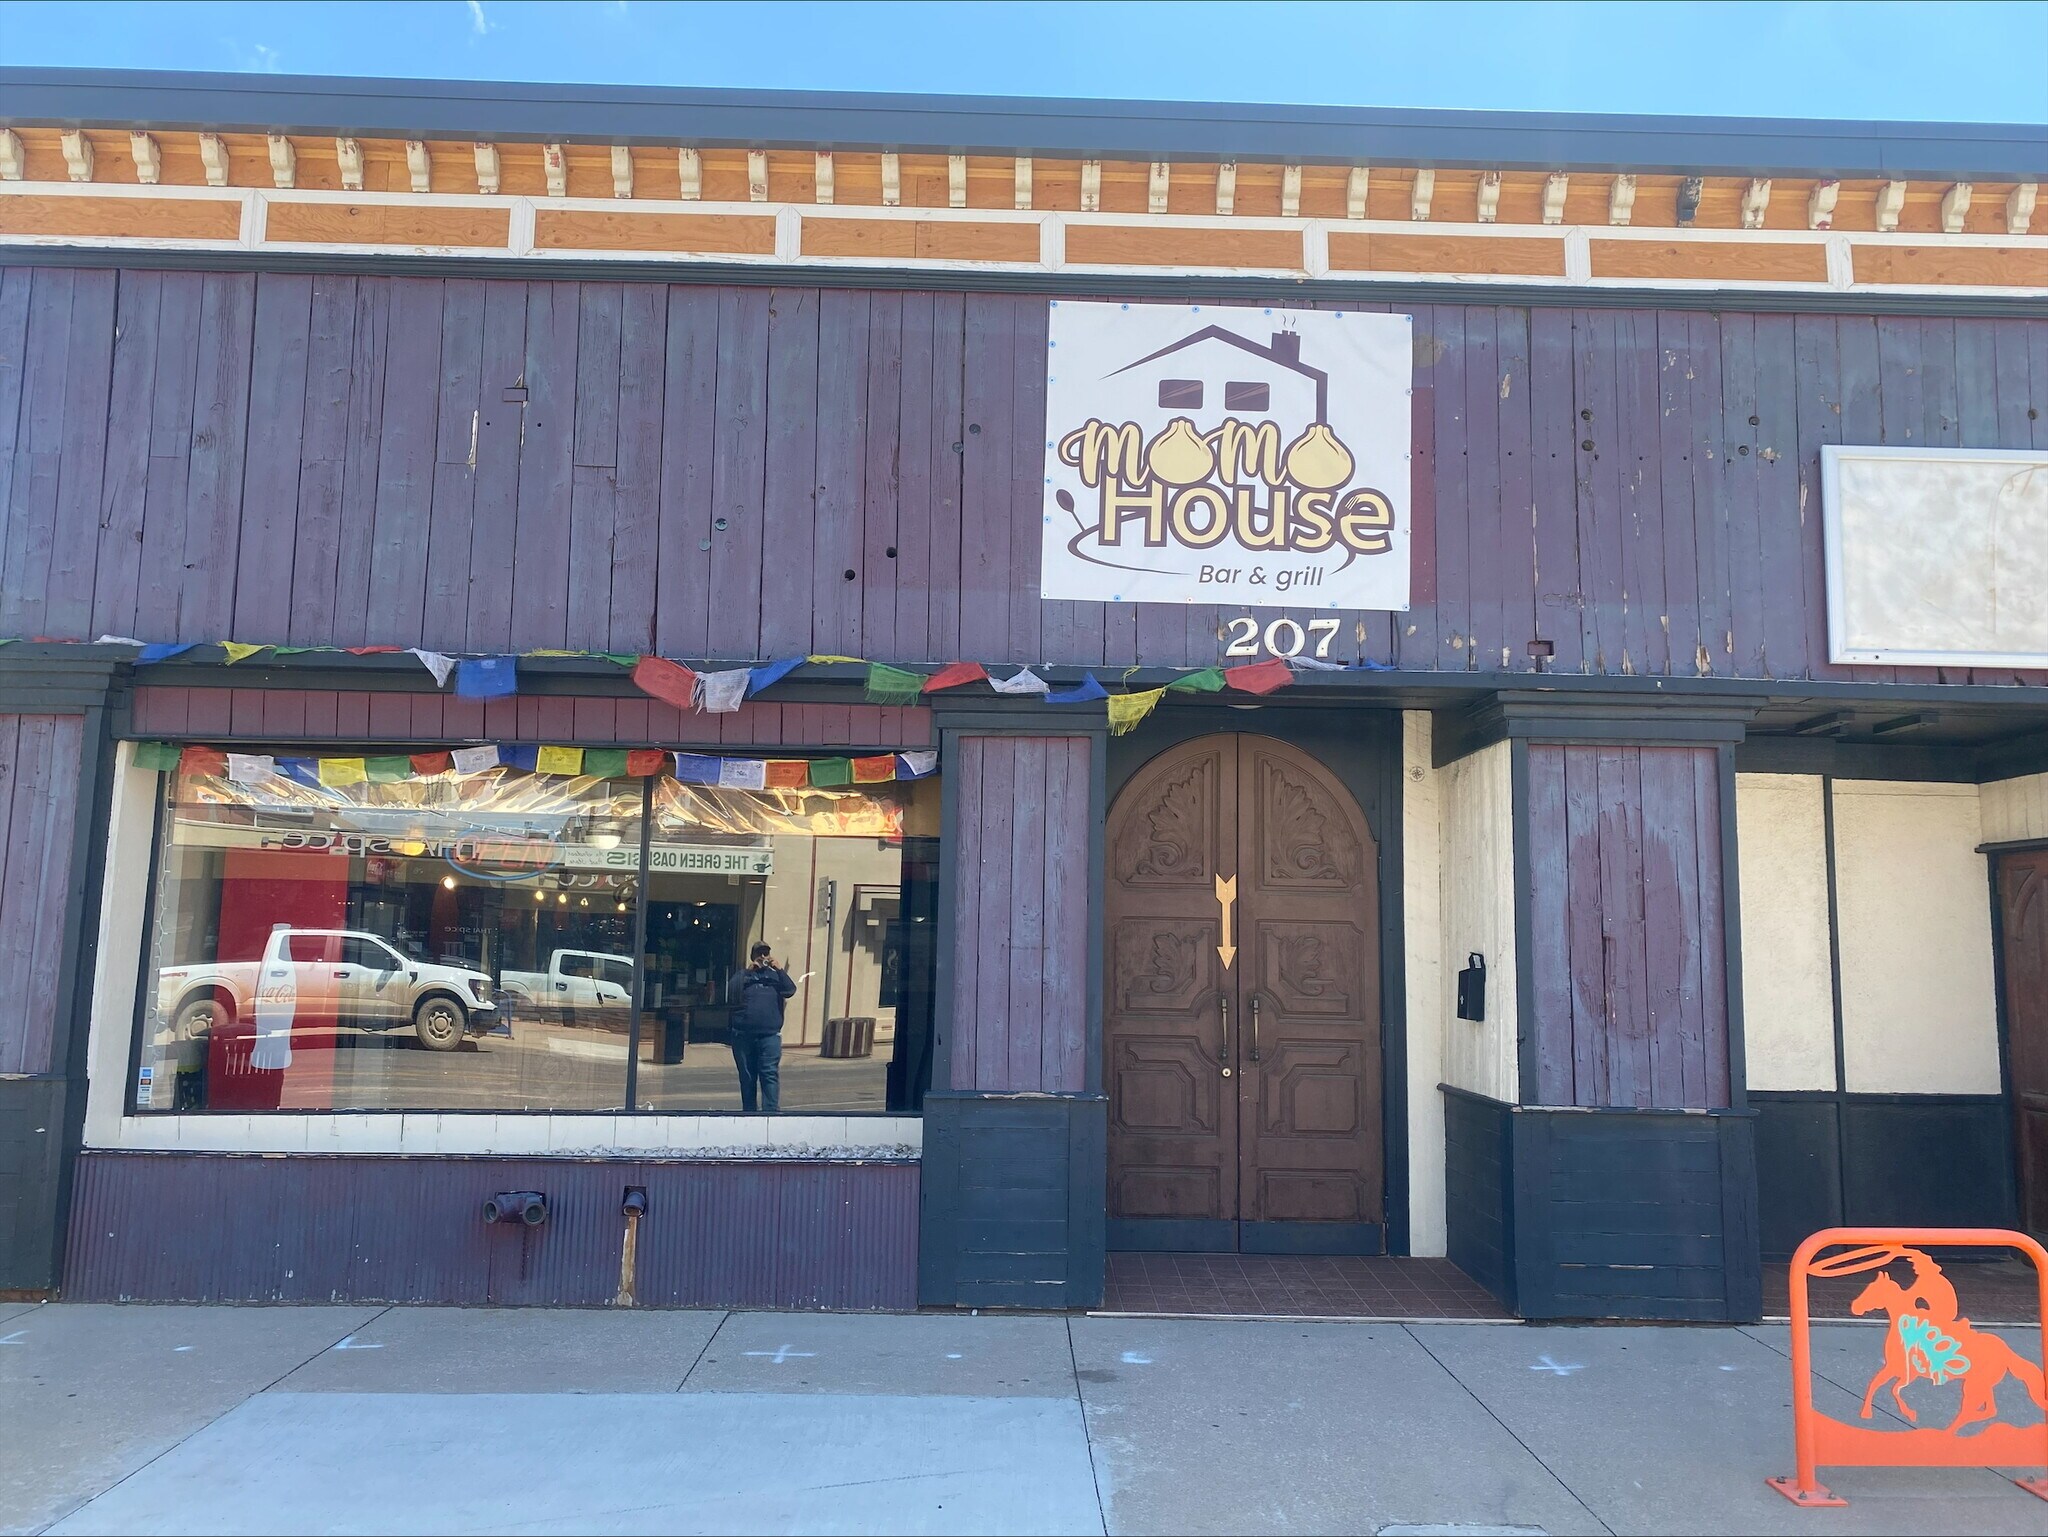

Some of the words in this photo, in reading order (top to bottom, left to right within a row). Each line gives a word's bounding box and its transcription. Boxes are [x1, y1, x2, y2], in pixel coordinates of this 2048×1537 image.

[1098, 477, 1395, 554] House
[1199, 565, 1242, 584] Bar
[1248, 566, 1267, 585] &
[1275, 566, 1324, 592] grill
[1225, 617, 1341, 658] 207
[452, 835, 555, 869] OPEN
